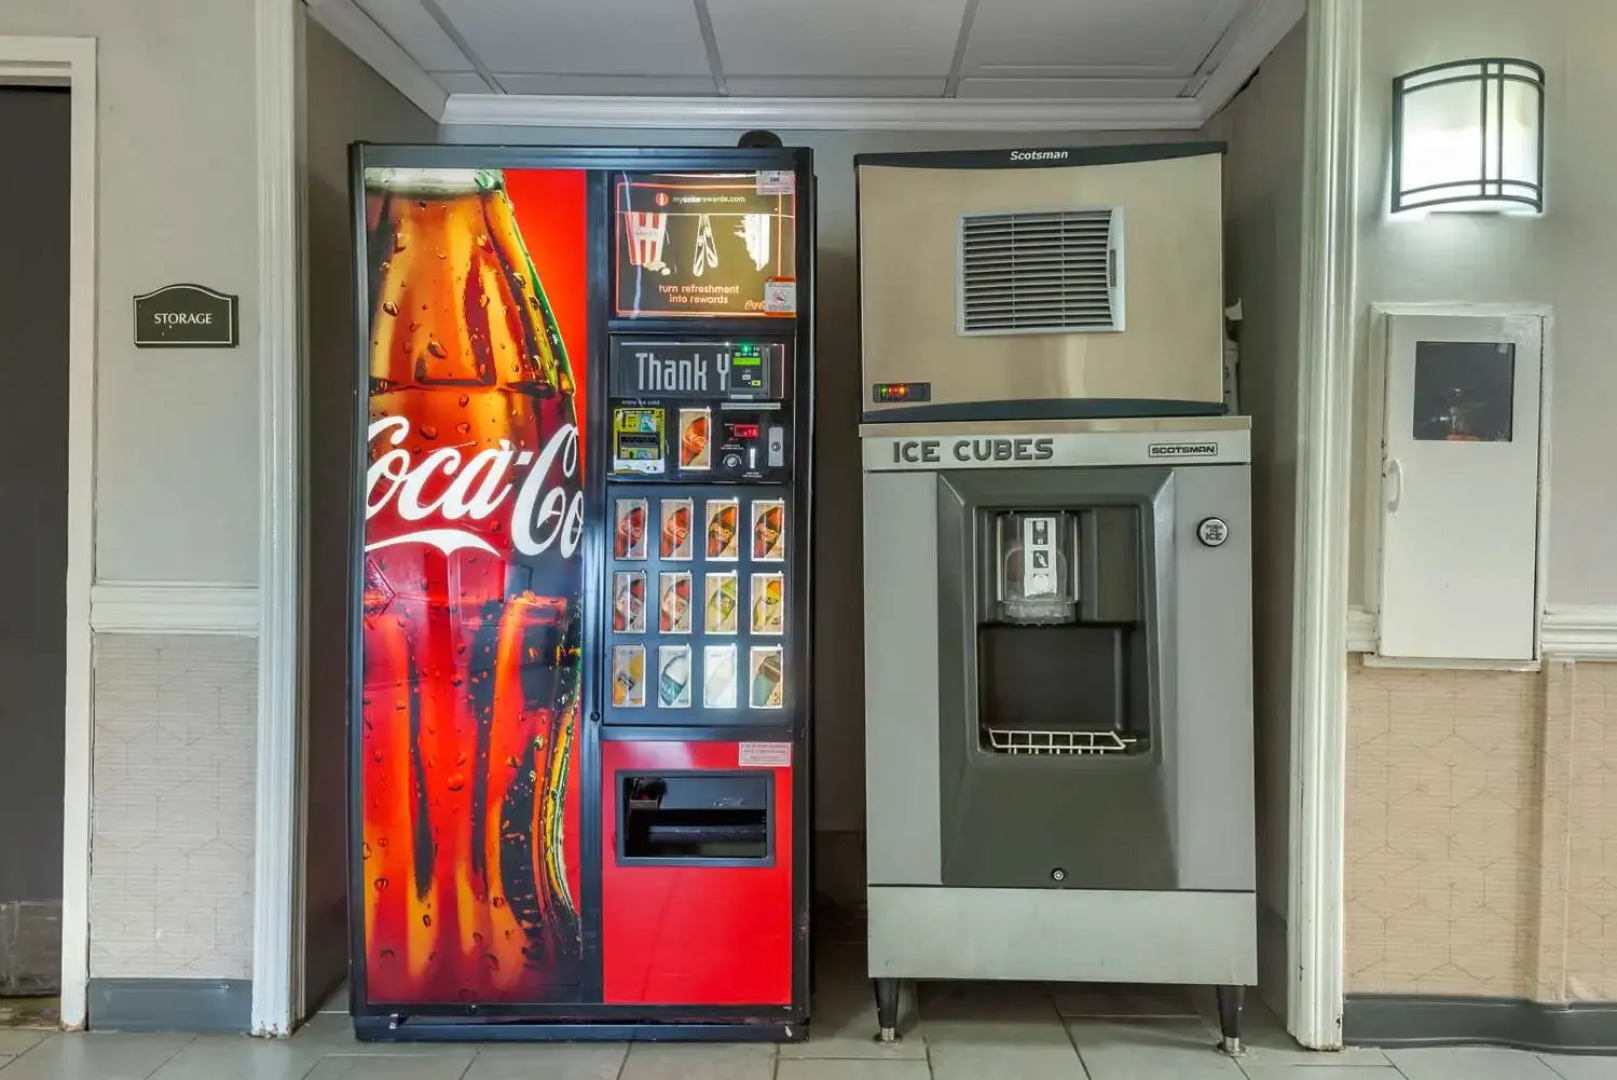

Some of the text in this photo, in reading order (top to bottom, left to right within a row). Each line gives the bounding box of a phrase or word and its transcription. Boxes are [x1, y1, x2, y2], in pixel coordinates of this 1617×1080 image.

[1010, 150, 1068, 160] Scotsman
[673, 196, 746, 205] mycokerewards.com
[659, 284, 740, 294] turn refreshment
[669, 294, 729, 304] into rewards
[154, 313, 213, 325] STORAGE
[636, 353, 729, 391] Thank Y
[893, 438, 1054, 463] ICE CUBES
[1151, 446, 1215, 454] SCOTSMAN
